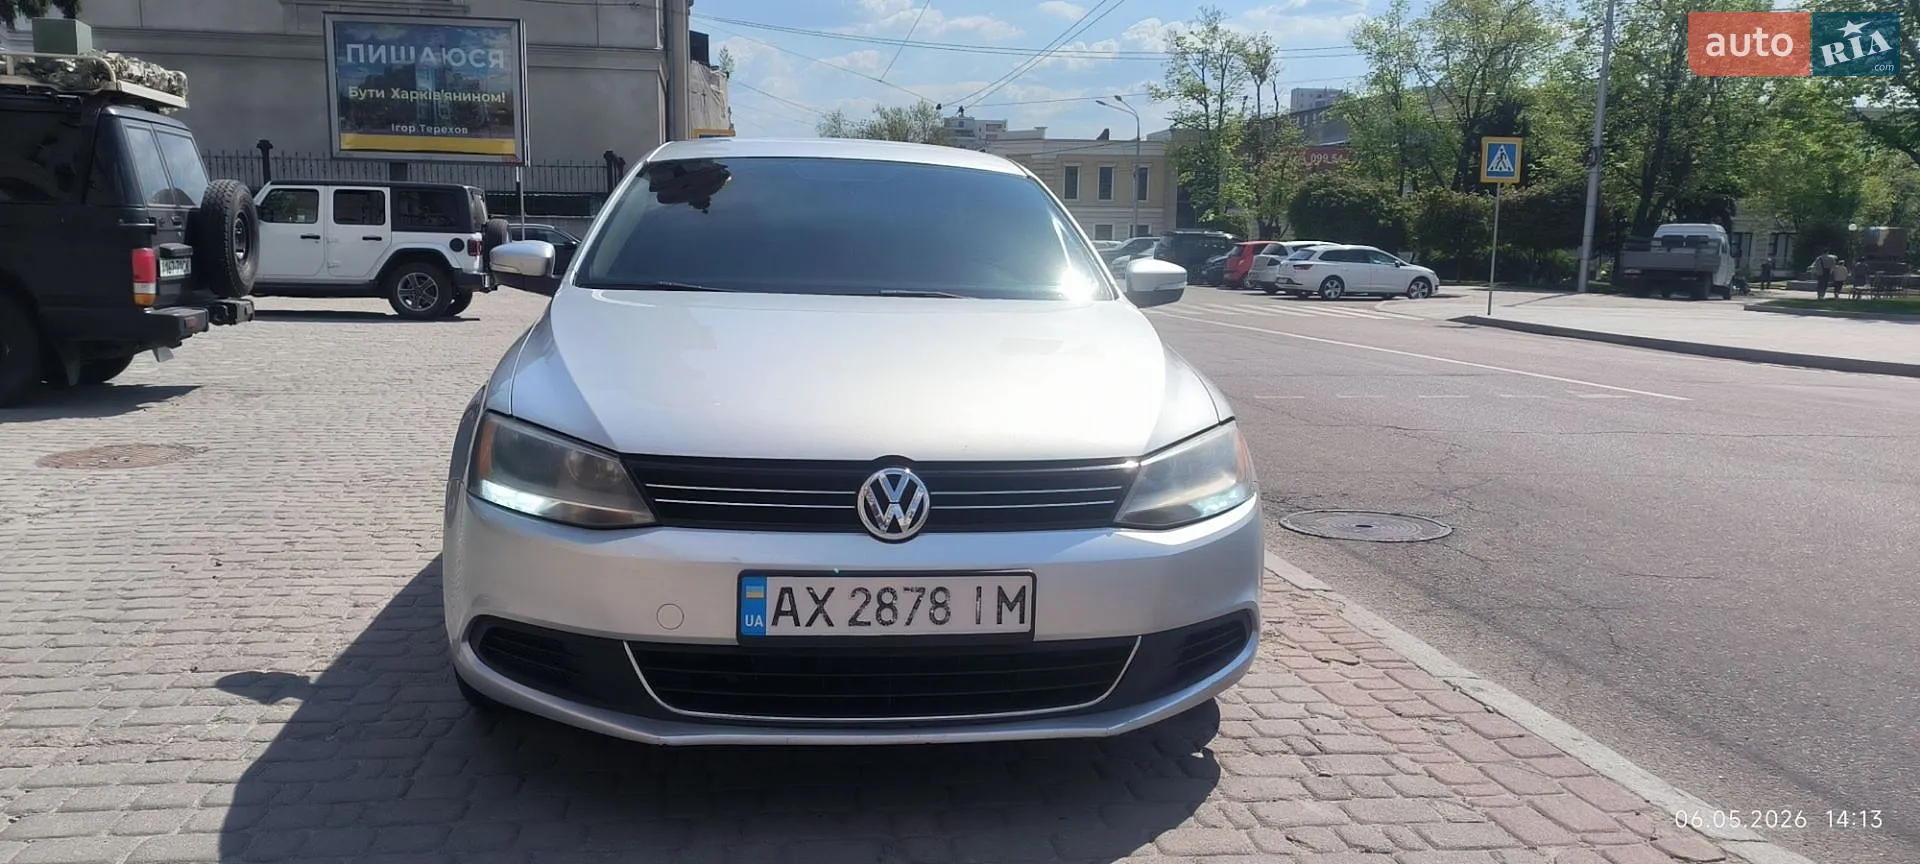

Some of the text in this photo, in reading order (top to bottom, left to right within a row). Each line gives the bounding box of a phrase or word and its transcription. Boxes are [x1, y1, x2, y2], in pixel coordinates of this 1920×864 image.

[346, 43, 505, 69] ПИШАЮСЯ
[348, 86, 506, 104] Бути Харків'янином!
[391, 124, 469, 135] Ігор Терехов
[861, 470, 927, 537] VW
[771, 586, 835, 627] AX
[847, 586, 952, 627] 2878
[744, 614, 764, 628] UA
